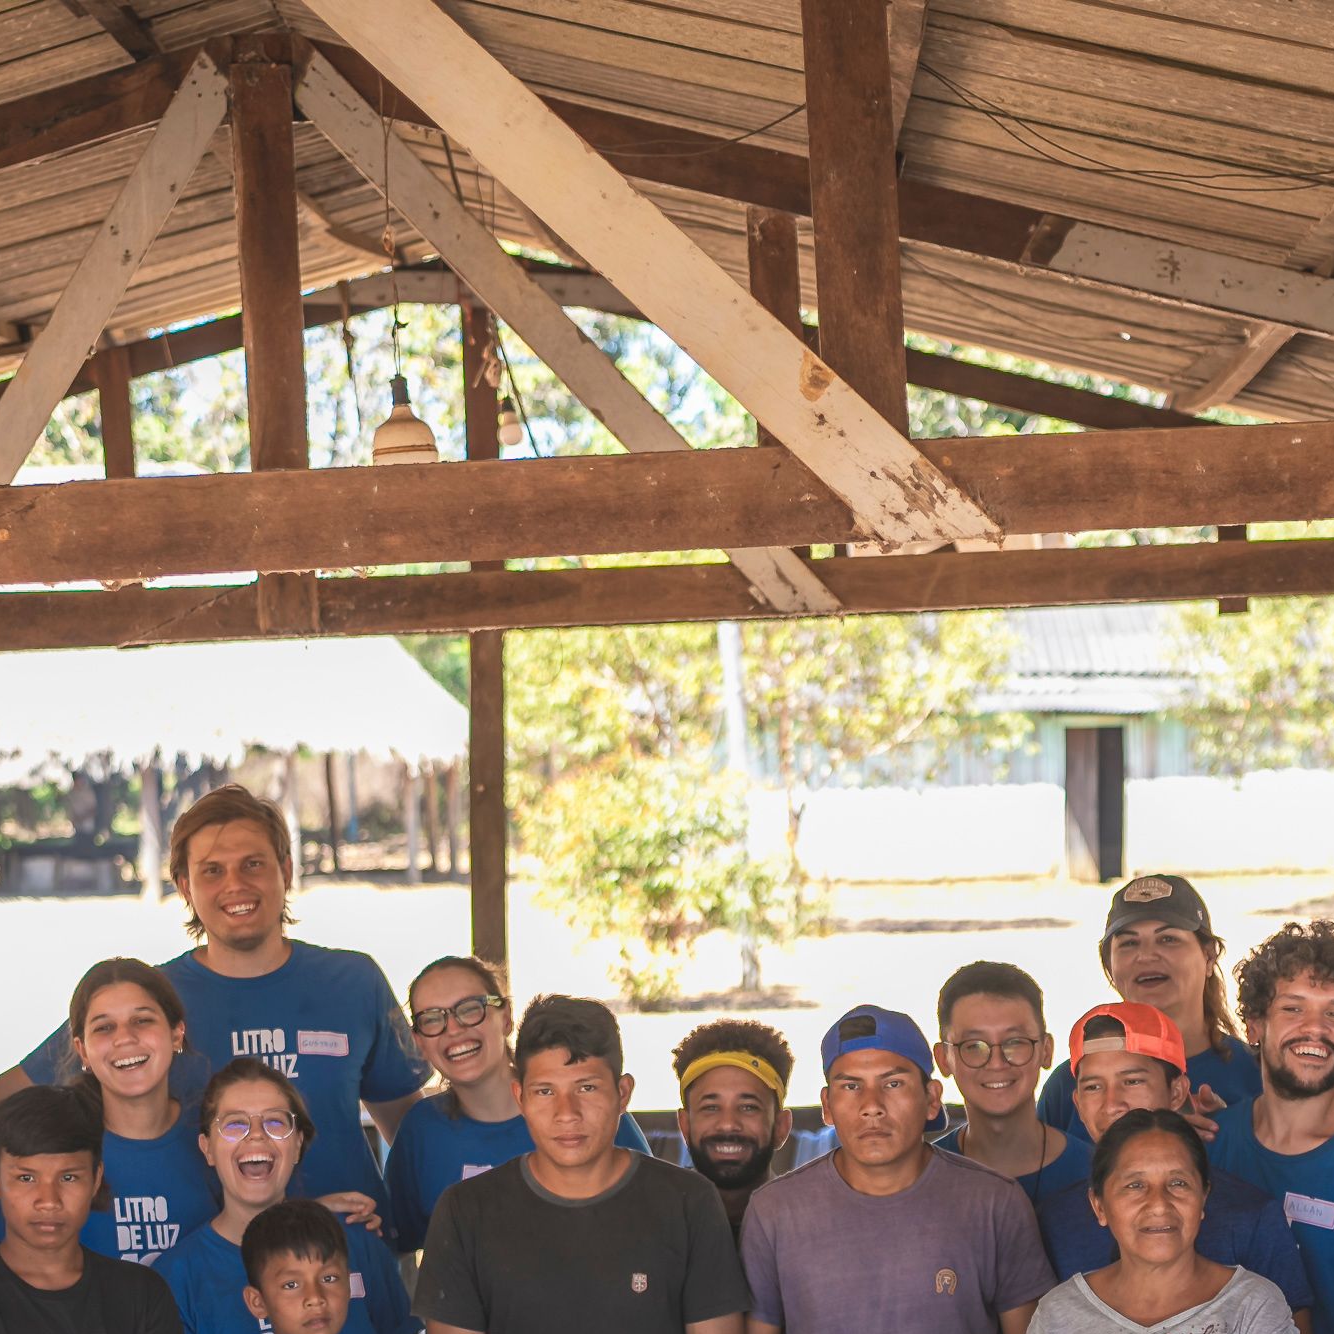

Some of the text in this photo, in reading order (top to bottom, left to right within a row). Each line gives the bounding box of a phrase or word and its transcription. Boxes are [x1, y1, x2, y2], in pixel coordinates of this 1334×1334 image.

[231, 1029, 285, 1056] LITRO
[113, 1195, 168, 1222] LITRO
[117, 1225, 143, 1251] DE
